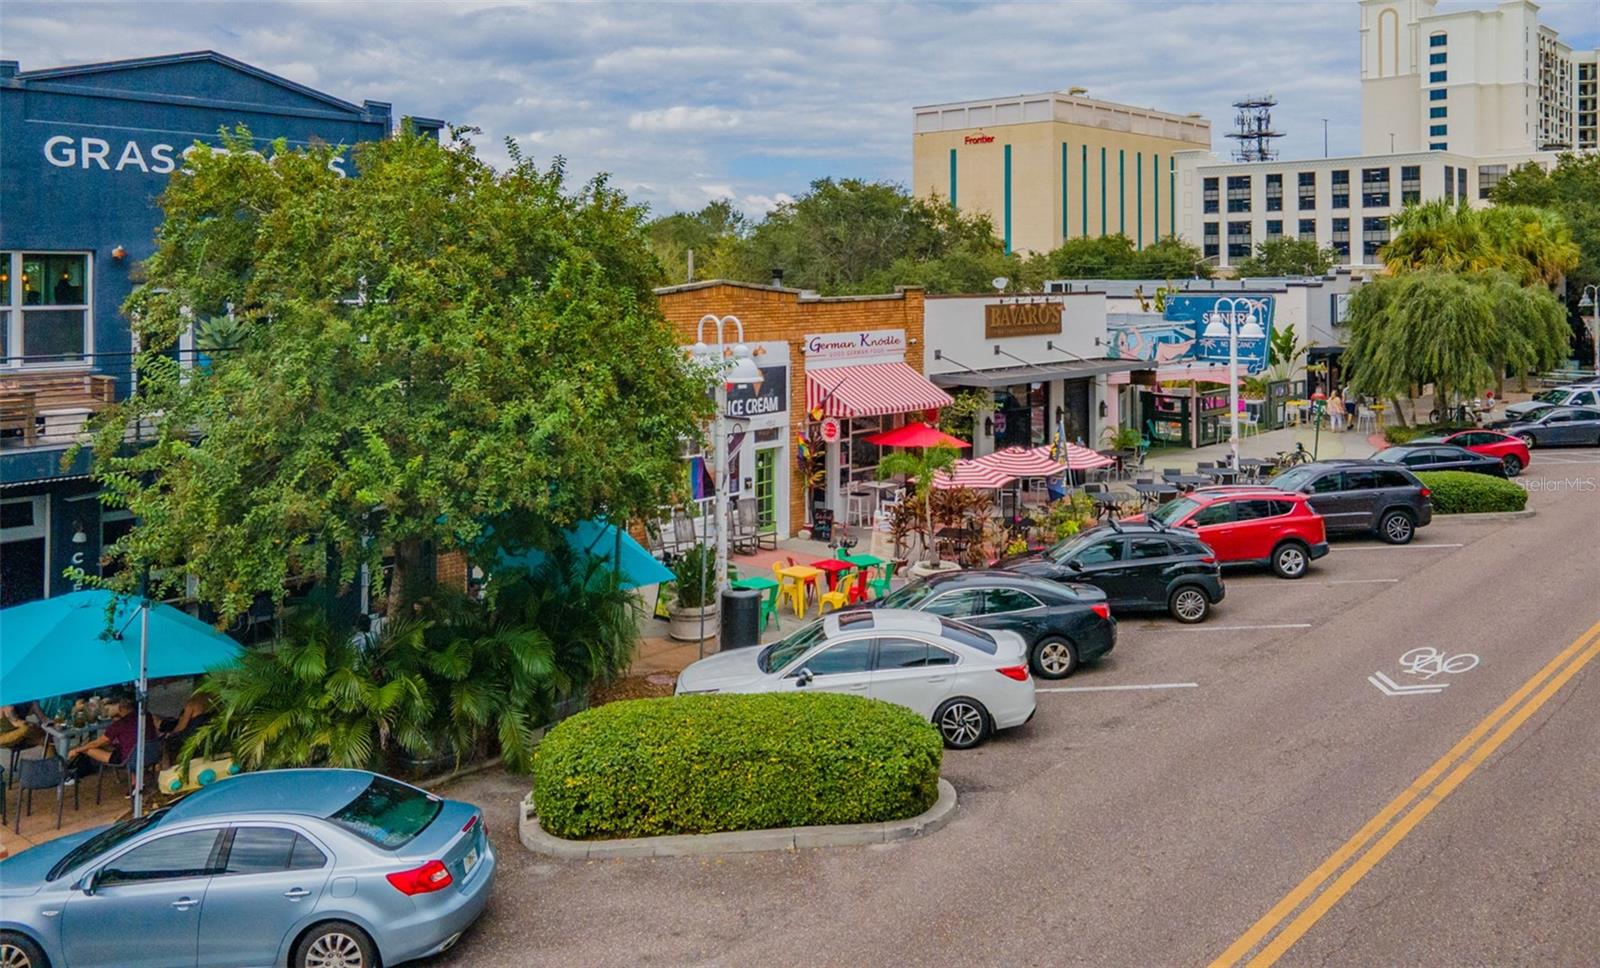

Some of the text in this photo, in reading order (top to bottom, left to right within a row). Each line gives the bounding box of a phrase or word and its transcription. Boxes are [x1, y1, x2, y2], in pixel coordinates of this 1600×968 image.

[964, 136, 995, 145] Frontier
[990, 304, 1060, 328] BAVARO'S
[809, 336, 856, 353] German
[727, 396, 779, 416] ICE CREAM
